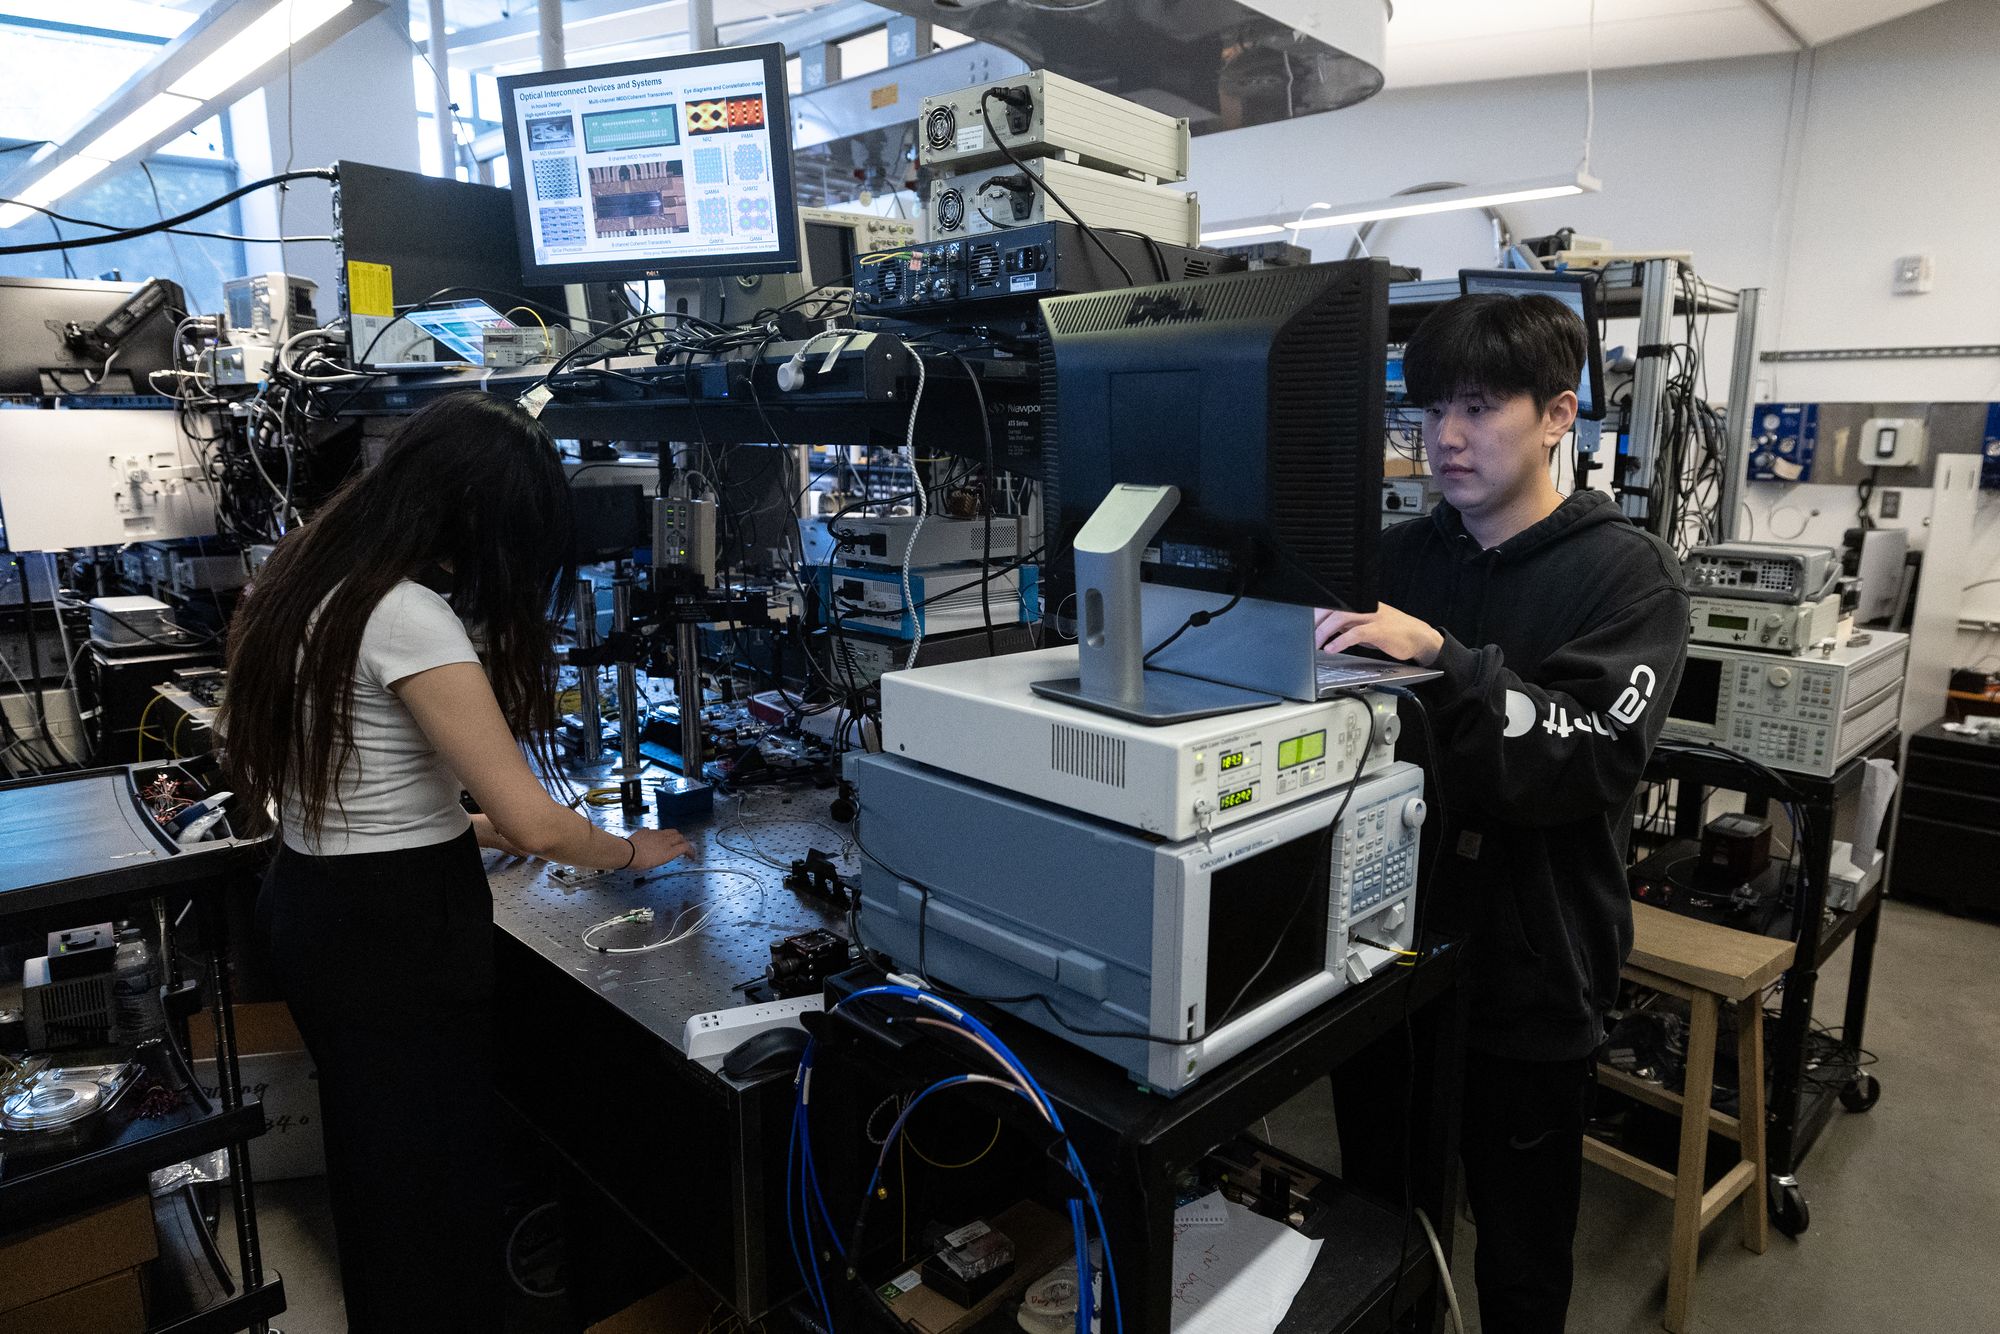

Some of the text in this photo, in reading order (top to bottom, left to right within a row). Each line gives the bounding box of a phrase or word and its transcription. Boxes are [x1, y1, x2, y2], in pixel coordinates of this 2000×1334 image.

[520, 78, 662, 102] Optical Interconnect Devices and Systems
[722, 82, 752, 90] Constellation
[589, 96, 616, 104] Multi-channel
[646, 91, 673, 99] Transceivers
[547, 108, 572, 116] Components
[1008, 404, 1041, 414] Newpo
[1200, 855, 1226, 870] YOKOGAWA
